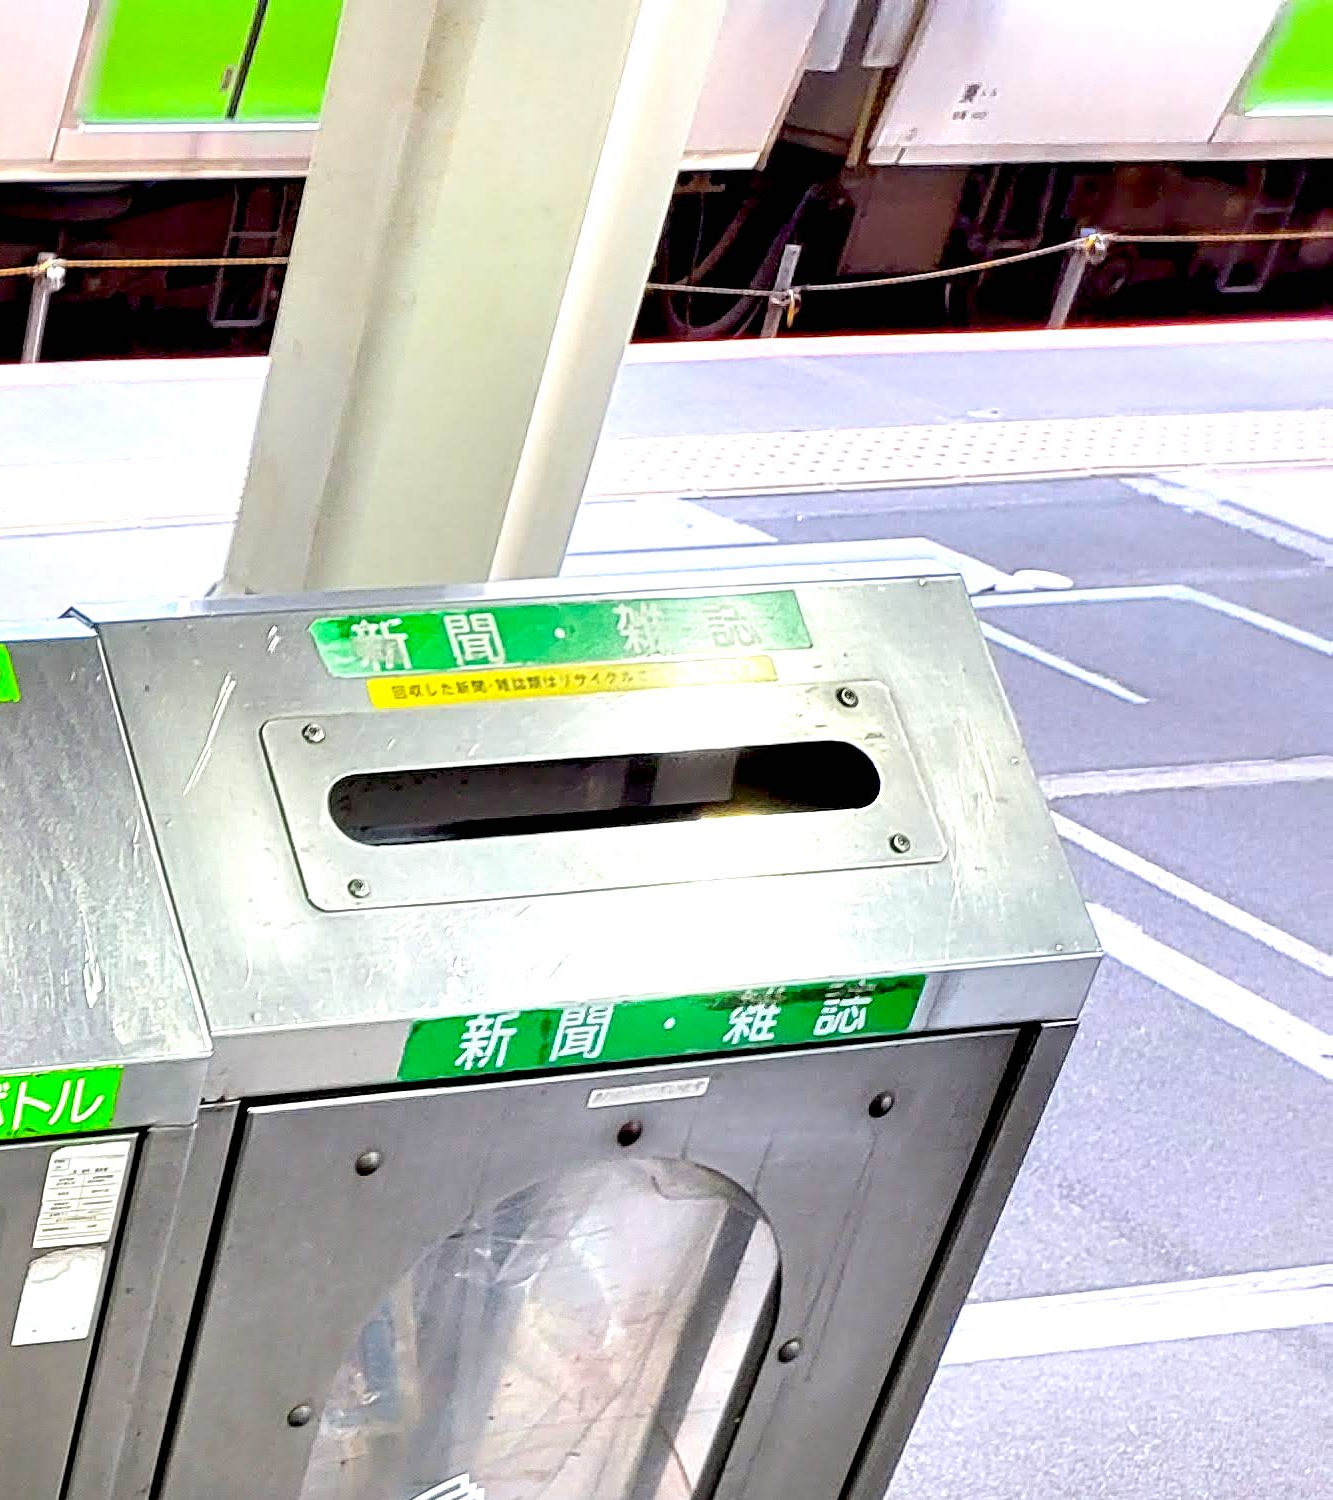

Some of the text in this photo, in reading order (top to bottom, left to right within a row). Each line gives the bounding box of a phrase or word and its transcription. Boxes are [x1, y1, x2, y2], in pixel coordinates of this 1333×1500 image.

[350, 601, 763, 671] 新聞・雑誌
[455, 984, 874, 1070] 新聞・雑誌
